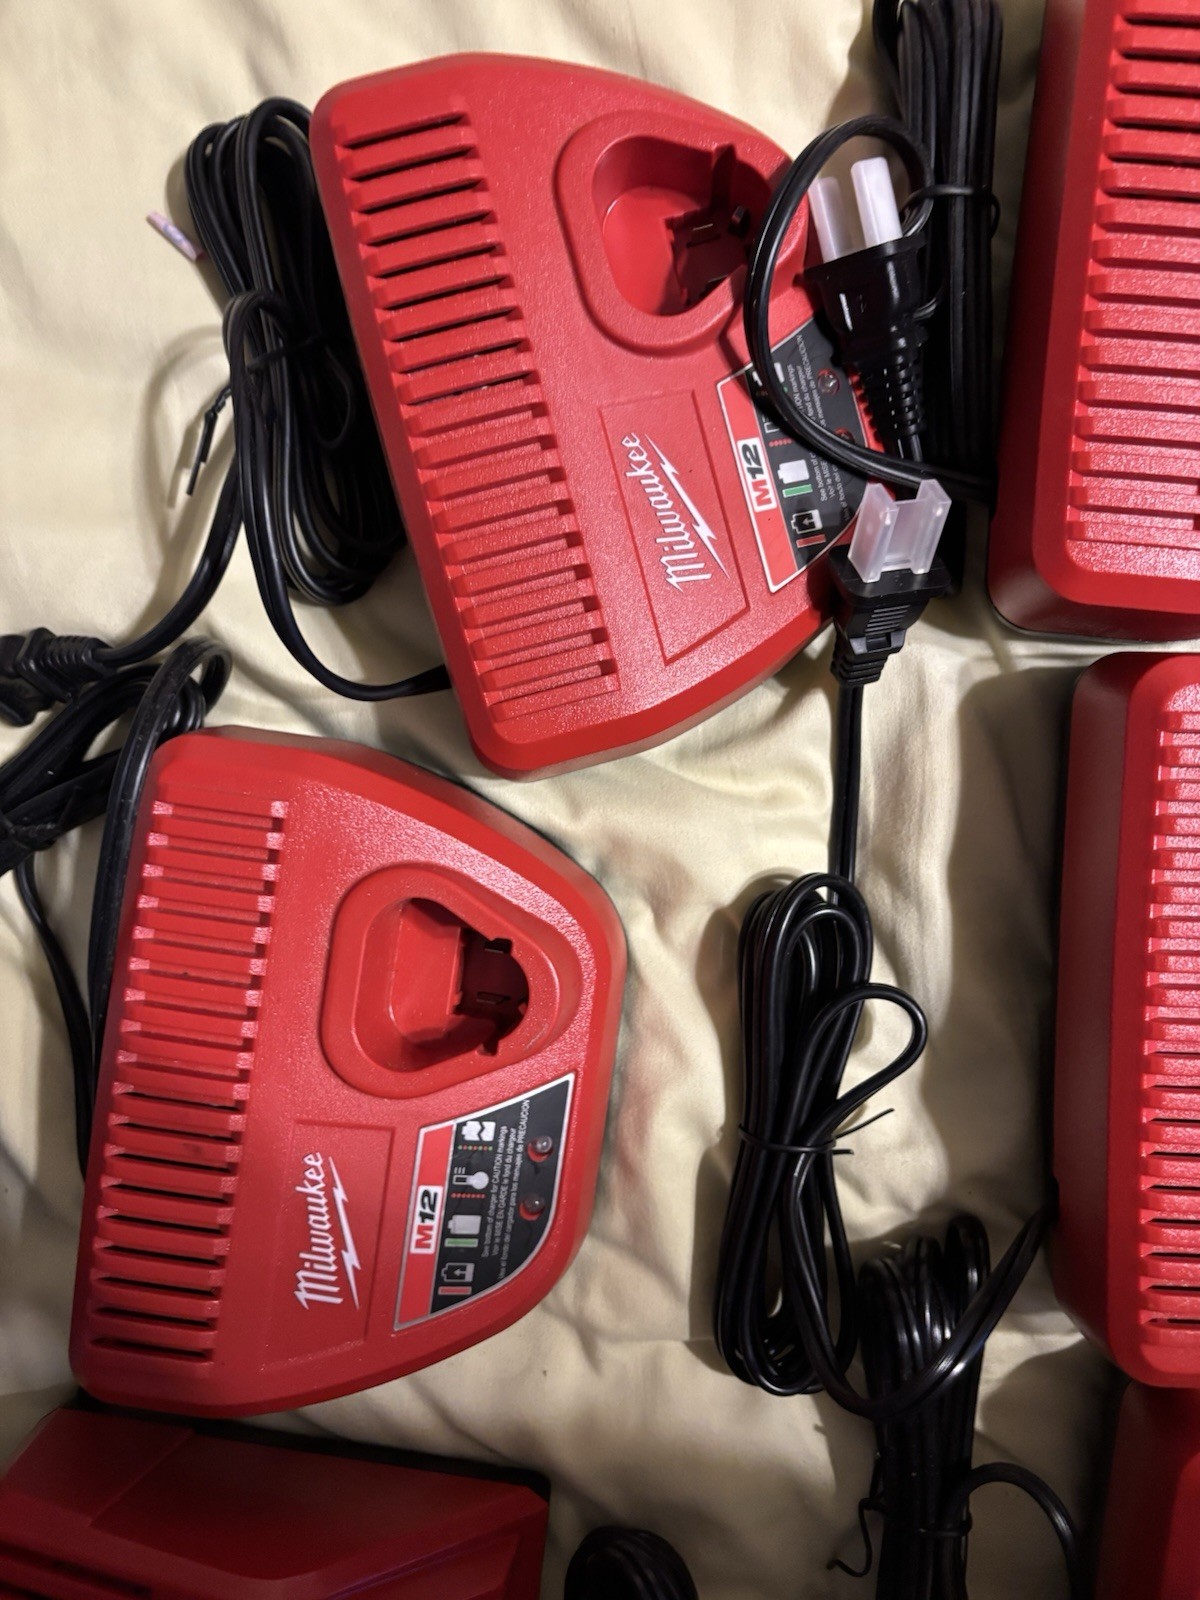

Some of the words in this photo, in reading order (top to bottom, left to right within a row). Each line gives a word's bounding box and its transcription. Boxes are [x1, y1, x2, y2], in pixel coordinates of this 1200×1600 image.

[787, 364, 799, 393] markings
[796, 365, 808, 393] chargeur
[809, 381, 816, 389] de
[804, 392, 810, 401] du
[805, 402, 814, 417] fond
[811, 458, 818, 466] of
[741, 443, 773, 507] M12
[813, 467, 824, 488] bottom
[820, 488, 828, 501] See
[827, 485, 836, 498] Voir
[836, 483, 845, 501] fondo
[621, 432, 712, 593] Milwaukee
[516, 1099, 530, 1144] PRECAUCION
[497, 1125, 508, 1154] markings
[507, 1127, 517, 1154] chargeur
[516, 1144, 524, 1153] de
[492, 1154, 502, 1183] CAUTION
[505, 1155, 513, 1163] du
[513, 1153, 523, 1181] mensajes
[502, 1164, 511, 1177] fond
[498, 1185, 509, 1209] GARDE
[511, 1182, 519, 1192] los
[488, 1194, 498, 1216] charger
[509, 1192, 517, 1206] para
[414, 1189, 438, 1249] M12
[496, 1209, 505, 1220] EN
[506, 1206, 515, 1233] cargador
[294, 1152, 344, 1310] Milwaukee
[484, 1223, 492, 1245] bottom
[494, 1221, 503, 1237] MISE
[481, 1245, 490, 1257] See
